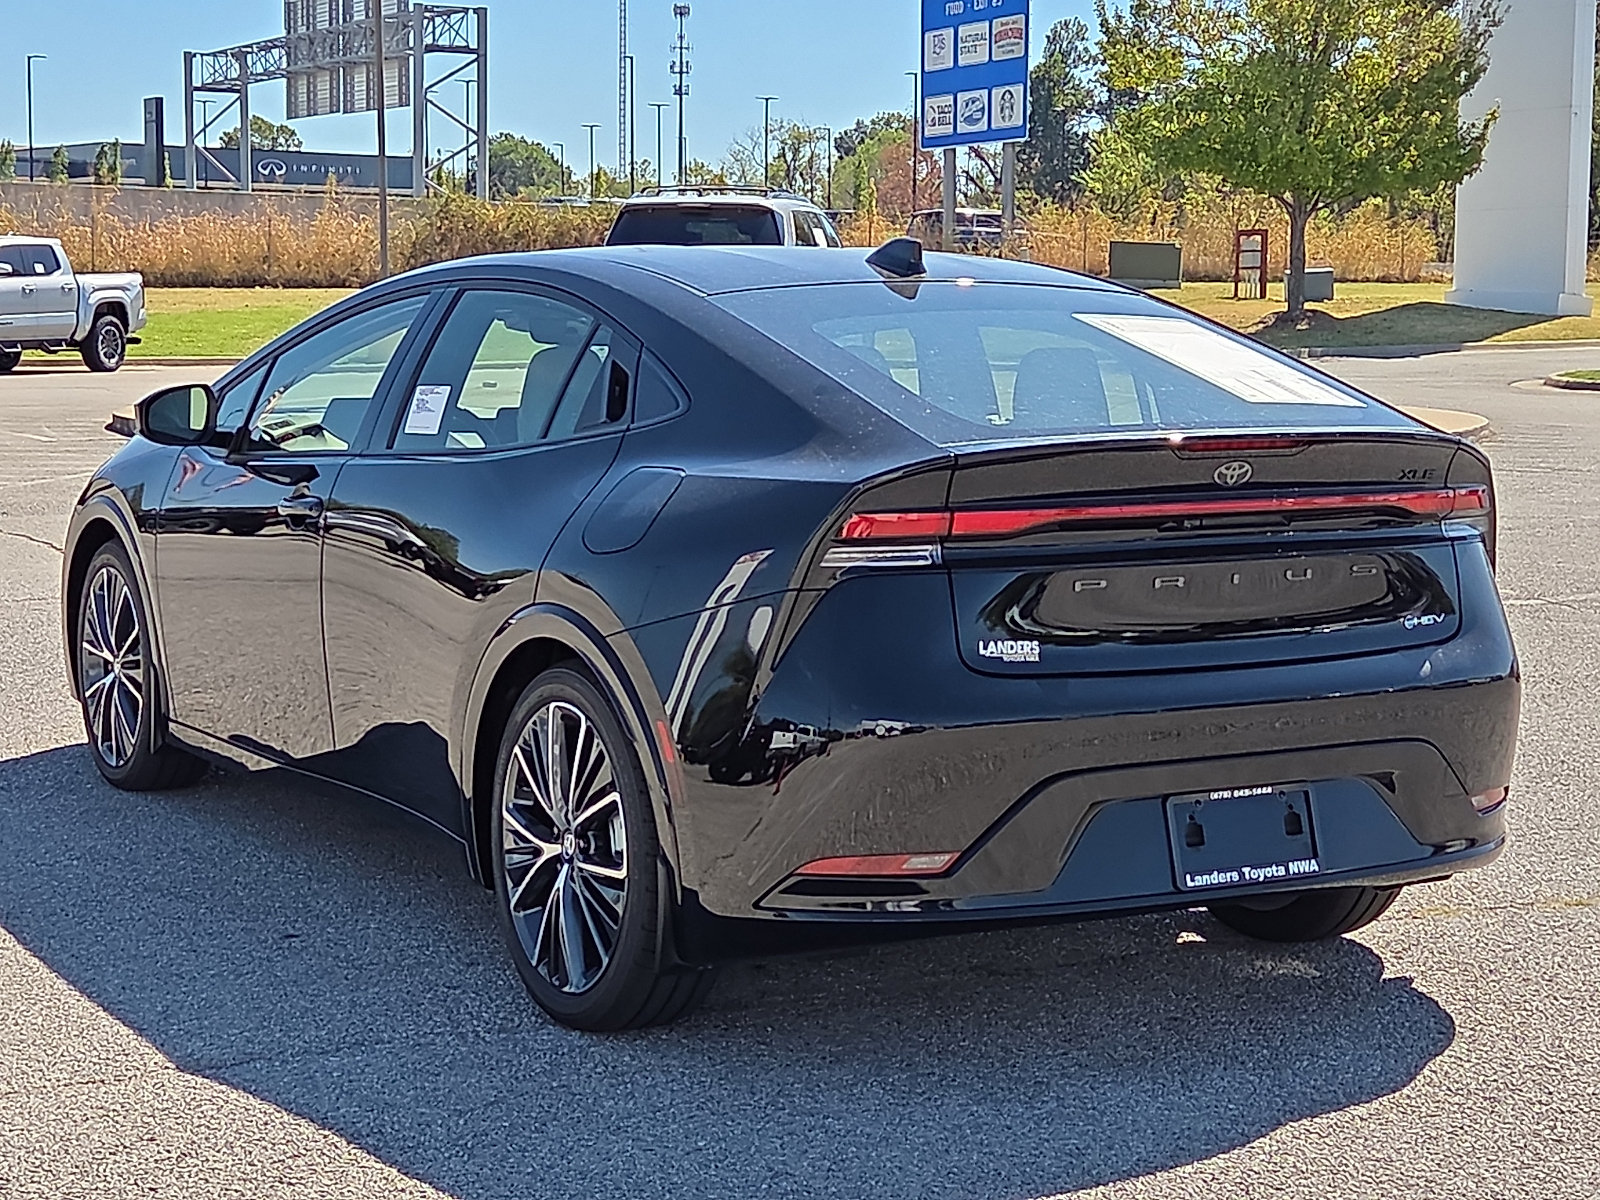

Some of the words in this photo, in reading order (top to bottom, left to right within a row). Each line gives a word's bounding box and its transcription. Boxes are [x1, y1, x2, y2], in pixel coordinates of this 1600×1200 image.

[960, 43, 978, 56] STATE
[937, 103, 952, 115] TACO
[937, 115, 952, 126] BELL
[292, 164, 360, 175] INFINITI
[1398, 468, 1436, 480] XLE
[1073, 563, 1378, 592] PRIUS
[978, 640, 1040, 655] LANDERS
[1185, 870, 1240, 887] Landers
[1241, 863, 1286, 881] Toyota
[1288, 859, 1320, 875] NWA
